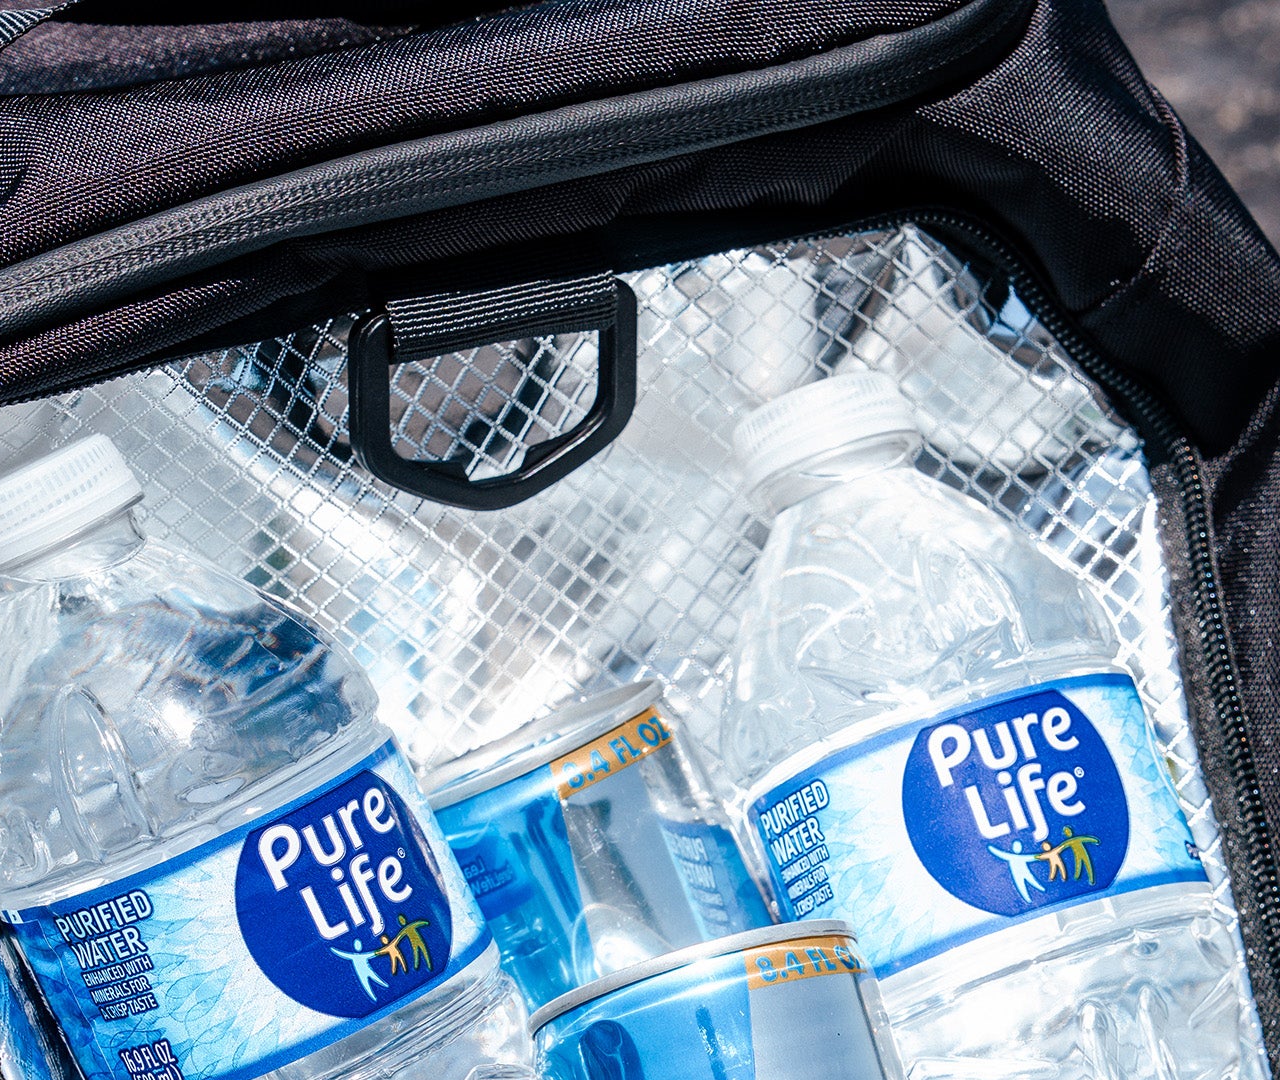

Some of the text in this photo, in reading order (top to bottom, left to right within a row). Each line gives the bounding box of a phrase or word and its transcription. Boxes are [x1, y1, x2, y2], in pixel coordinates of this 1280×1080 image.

[608, 735, 641, 764] FL
[637, 716, 671, 747] OZ
[927, 705, 1079, 788] Pure
[760, 780, 829, 839] PURIFIED
[258, 784, 396, 891] Pure
[770, 817, 825, 867] WATER
[55, 889, 152, 942] PURIFIED
[70, 926, 147, 969] WATER
[755, 951, 805, 982] 8.4
[804, 946, 837, 973] FL
[82, 956, 153, 987] ENHANCED WITH
[91, 976, 151, 1004] MINERALS FOR
[100, 994, 157, 1020] A CRISP TASTE
[120, 1041, 176, 1073] 16.9 FL OZ
